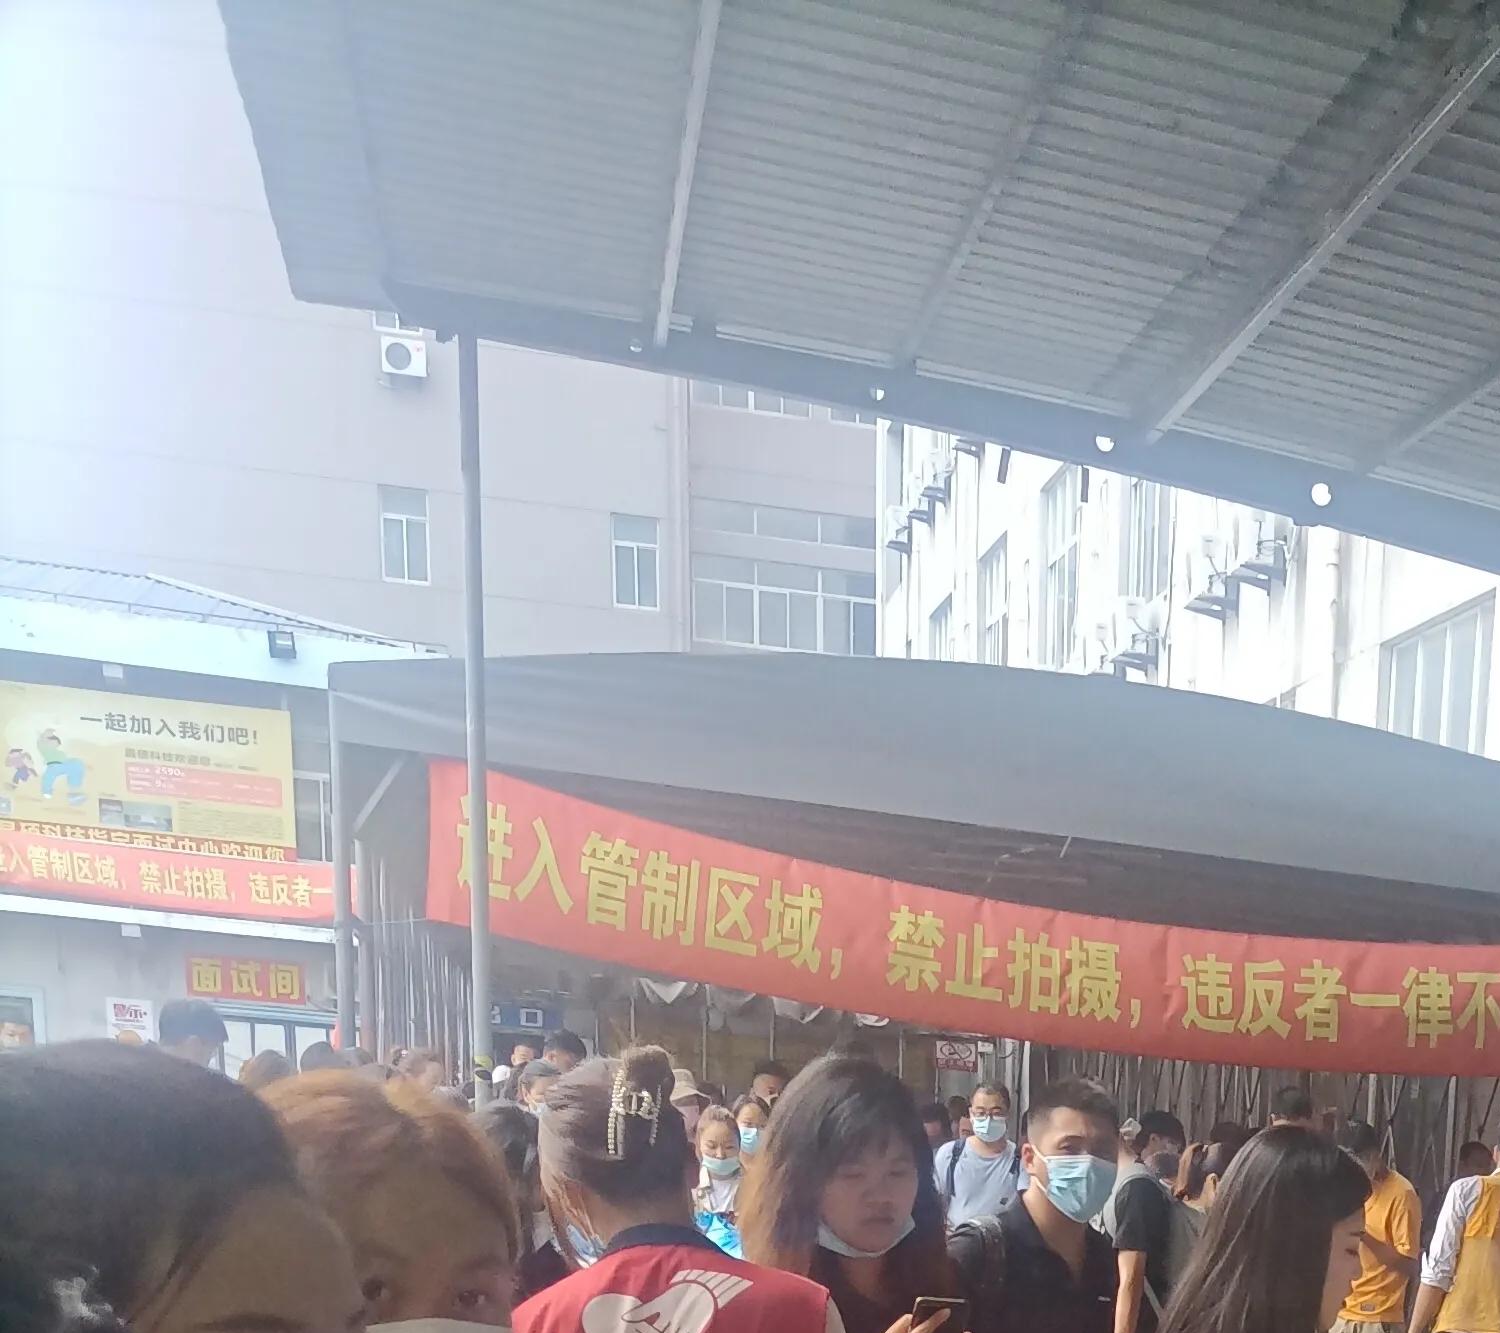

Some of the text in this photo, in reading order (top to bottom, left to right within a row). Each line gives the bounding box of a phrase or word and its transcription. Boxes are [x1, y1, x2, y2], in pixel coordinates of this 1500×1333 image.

[80, 712, 258, 746] 一起加入我们吧！
[191, 957, 300, 1001] 面试间
